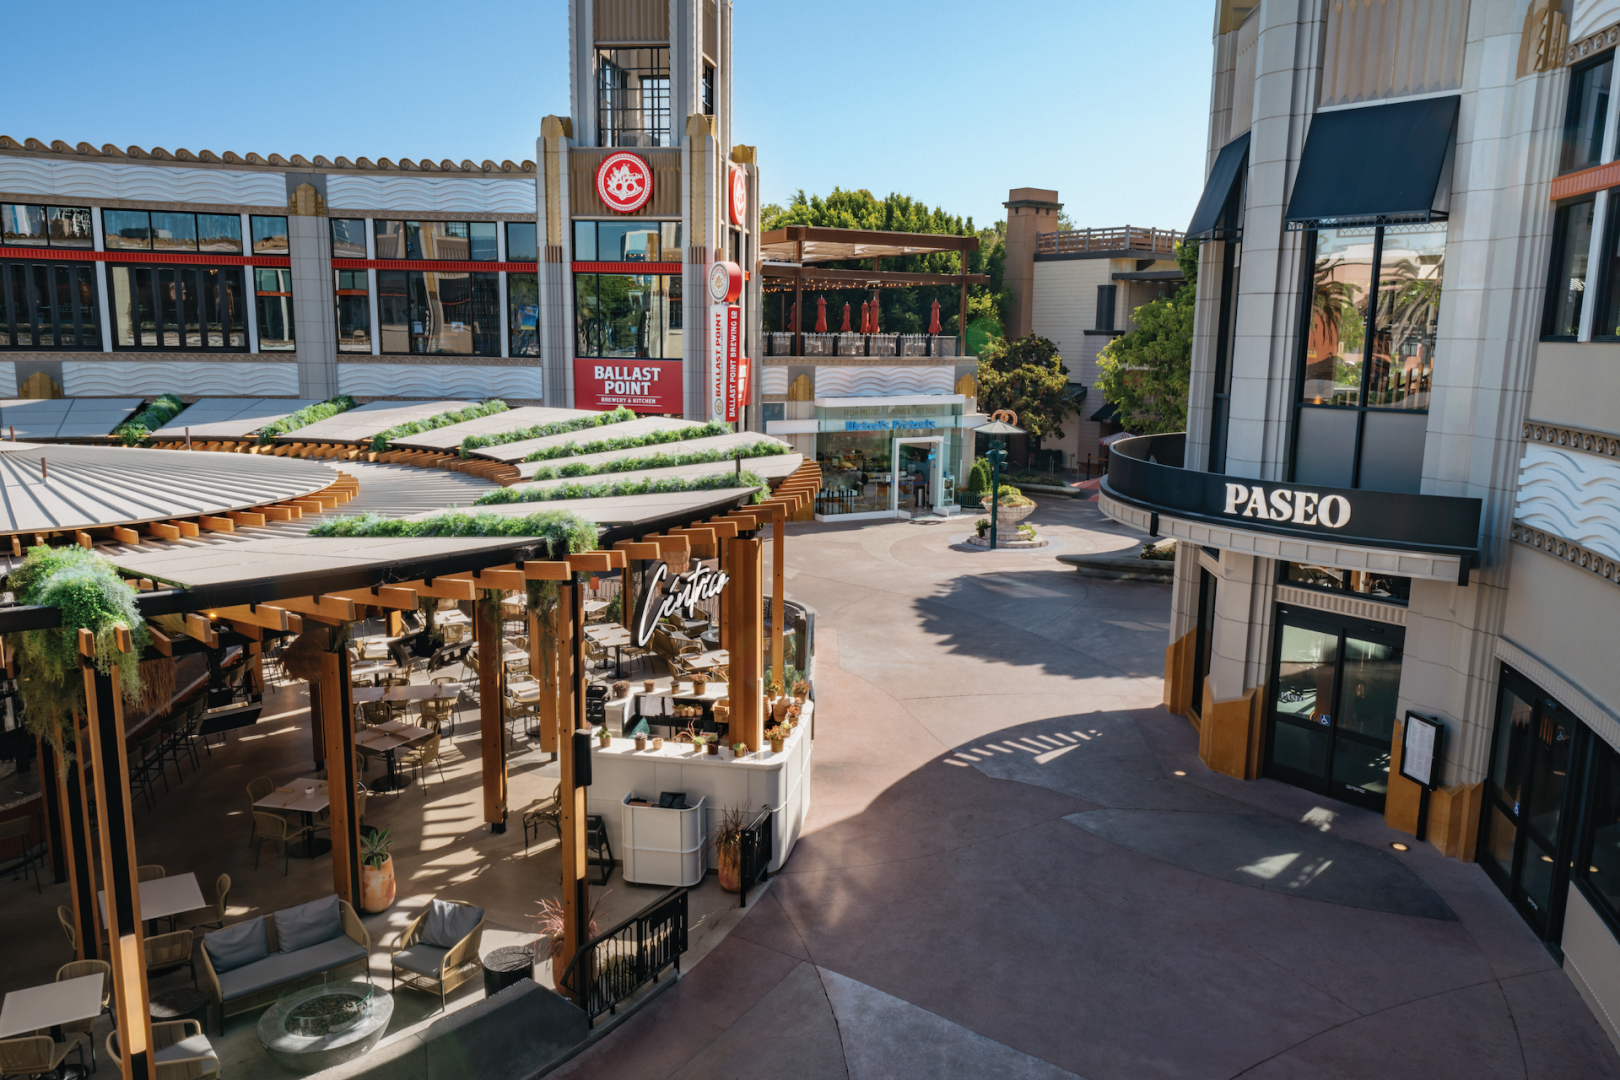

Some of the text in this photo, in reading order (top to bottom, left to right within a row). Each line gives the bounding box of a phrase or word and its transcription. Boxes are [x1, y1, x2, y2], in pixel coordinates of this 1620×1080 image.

[594, 365, 661, 381] BALLAST
[604, 380, 651, 395] POINT
[845, 419, 936, 431] Wetzel's Pretzels
[1223, 482, 1352, 528] PASEO
[1280, 691, 1306, 703] PASEO
